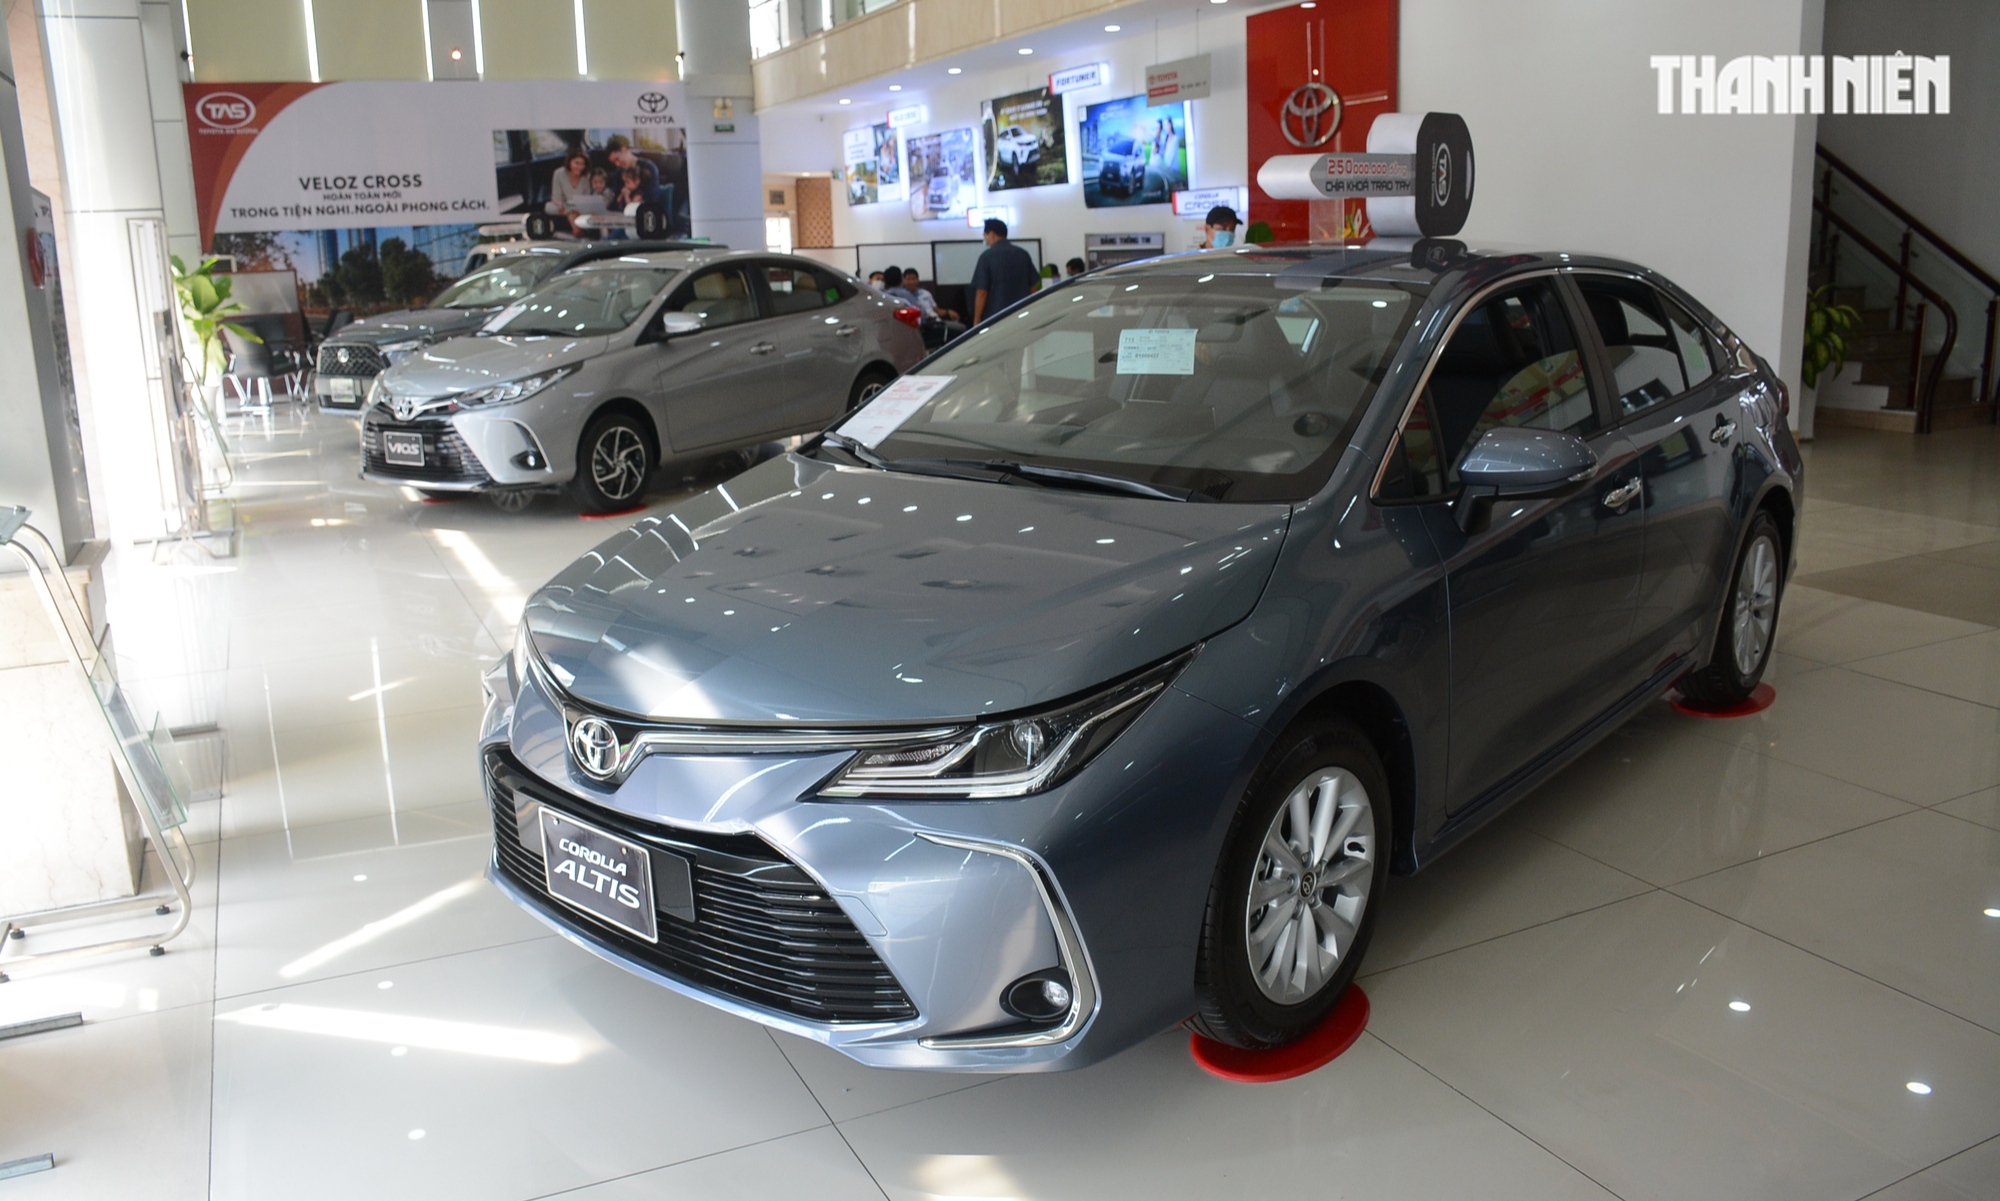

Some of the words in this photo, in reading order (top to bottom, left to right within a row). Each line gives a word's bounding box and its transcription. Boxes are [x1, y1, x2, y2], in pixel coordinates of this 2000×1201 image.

[1056, 70, 1096, 87] FORTUNER
[205, 103, 247, 119] TAS
[633, 115, 676, 125] TOYOTA
[299, 176, 358, 191] VELOZ
[363, 174, 423, 189] CROSS
[1438, 153, 1447, 196] TAS
[1371, 181, 1394, 191] TRAO
[1395, 181, 1411, 191] TAY
[231, 206, 279, 218] TRONG
[282, 202, 312, 220] TIỆN
[401, 200, 448, 213] PHONG
[388, 442, 419, 455] VIOS
[559, 838, 627, 877] COROLLA
[554, 859, 641, 909] ALTIS
